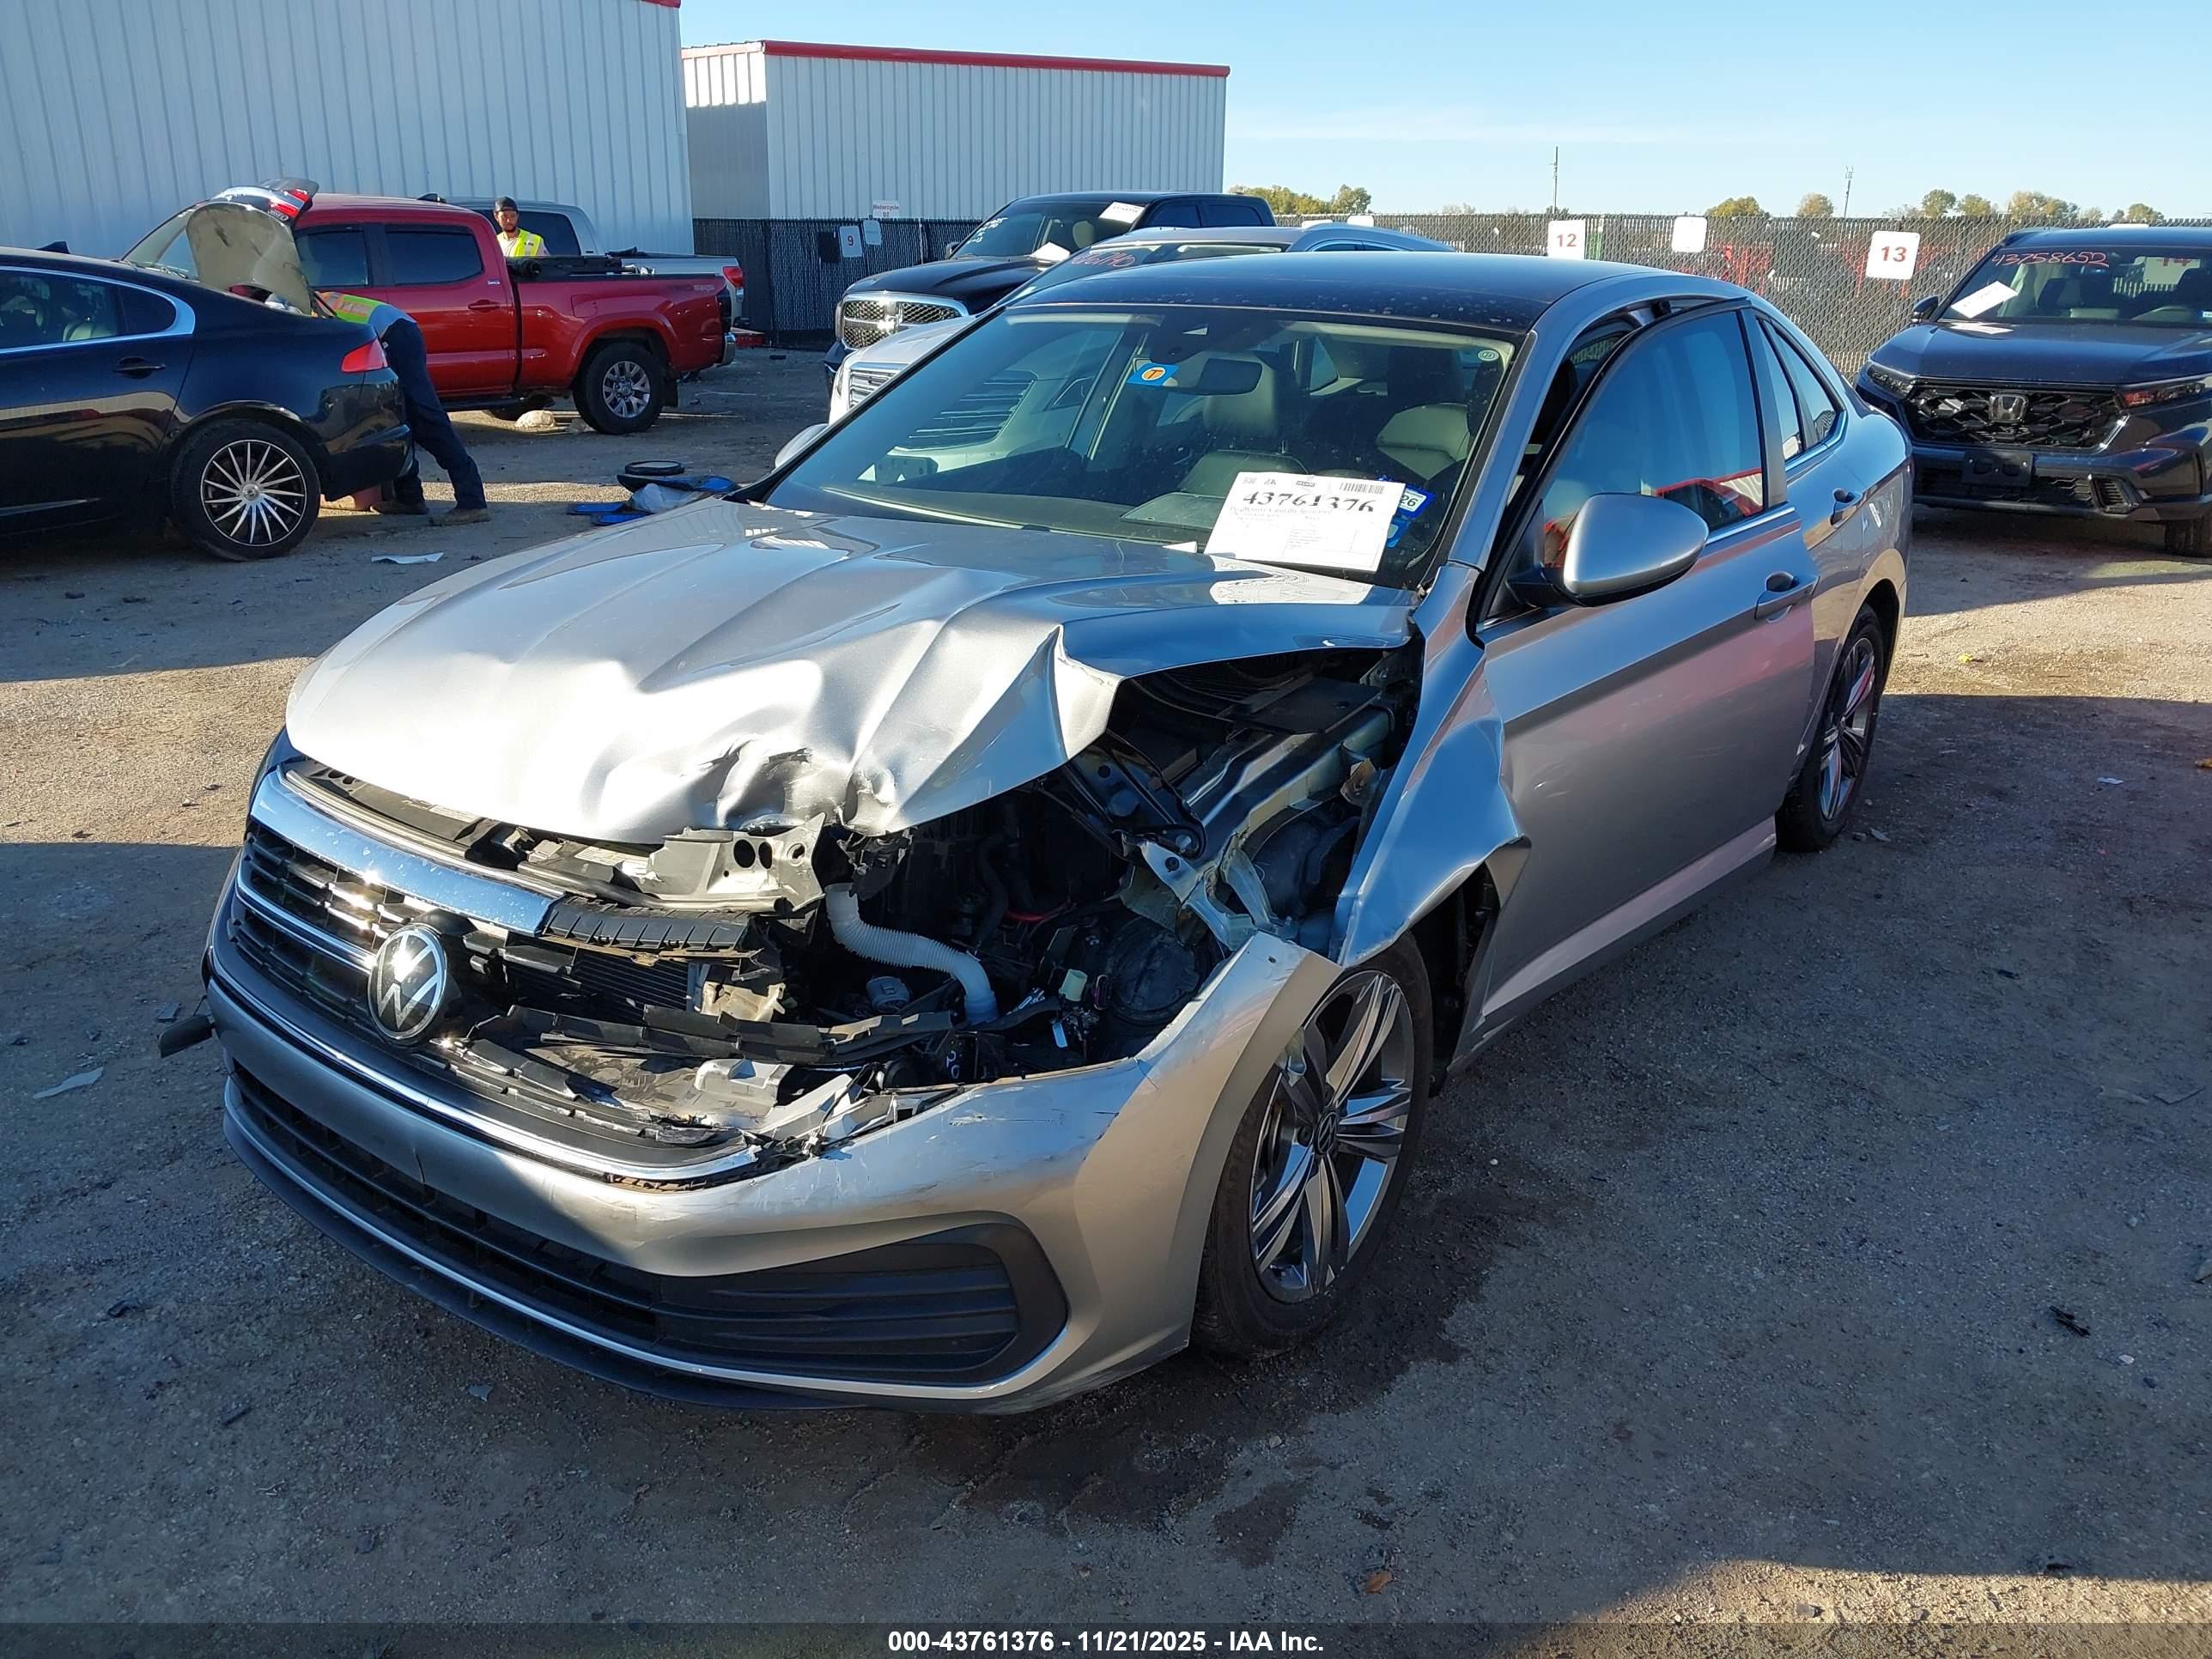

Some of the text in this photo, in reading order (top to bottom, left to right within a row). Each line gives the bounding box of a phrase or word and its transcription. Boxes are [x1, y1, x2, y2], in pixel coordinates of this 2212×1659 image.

[847, 235, 854, 246] 9
[1557, 233, 1577, 247] 12
[1881, 245, 1908, 264] 13
[1991, 251, 2110, 269] 43758652
[1243, 490, 1377, 513] 43761376
[1400, 495, 1419, 507] 26
